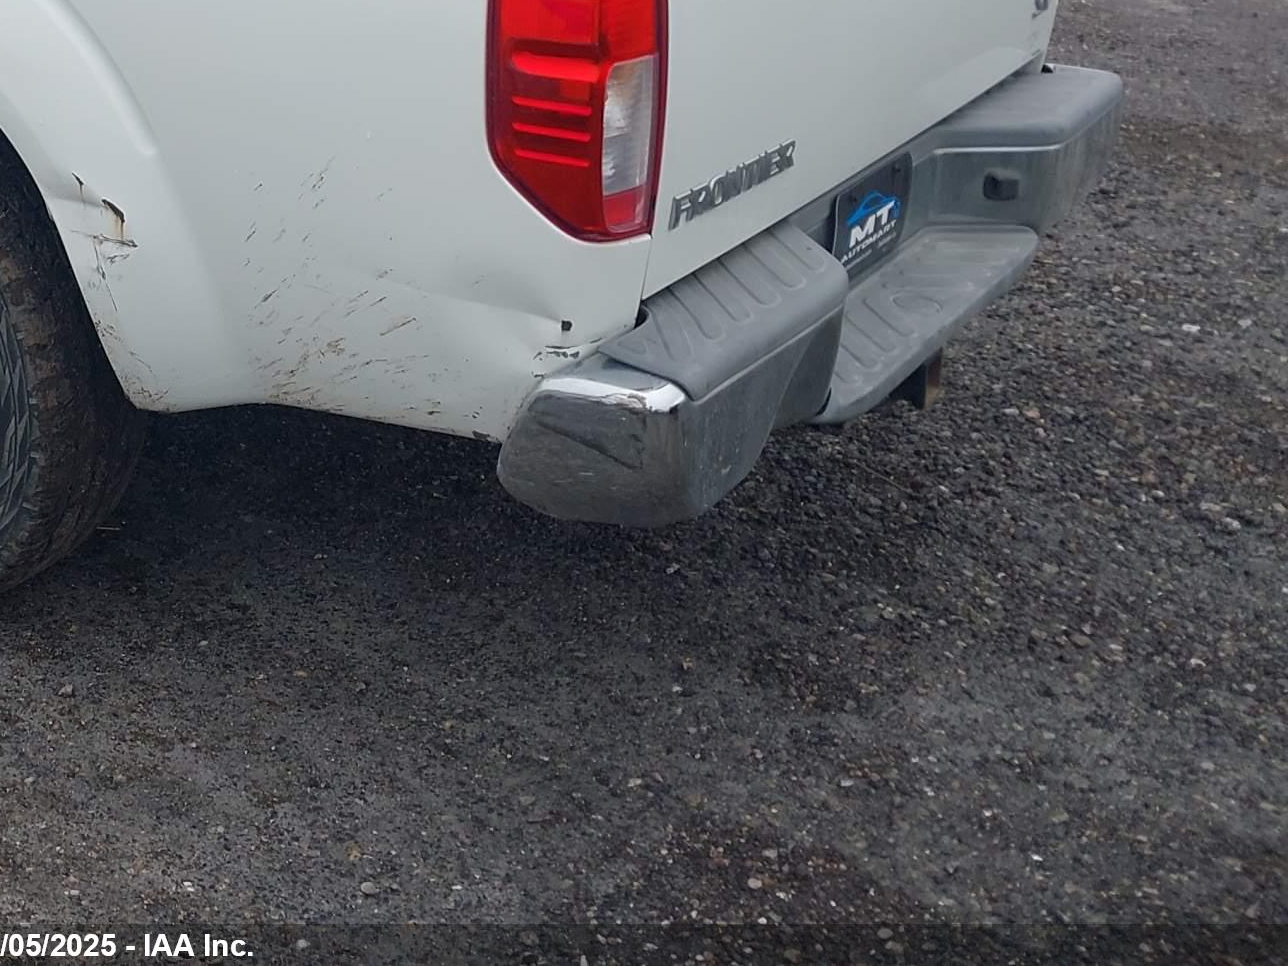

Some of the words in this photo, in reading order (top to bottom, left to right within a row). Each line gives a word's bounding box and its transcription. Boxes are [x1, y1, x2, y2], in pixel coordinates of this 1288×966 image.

[669, 138, 796, 230] FRONTIER
[840, 219, 897, 264] AUTOMART
[849, 200, 895, 248] MT
